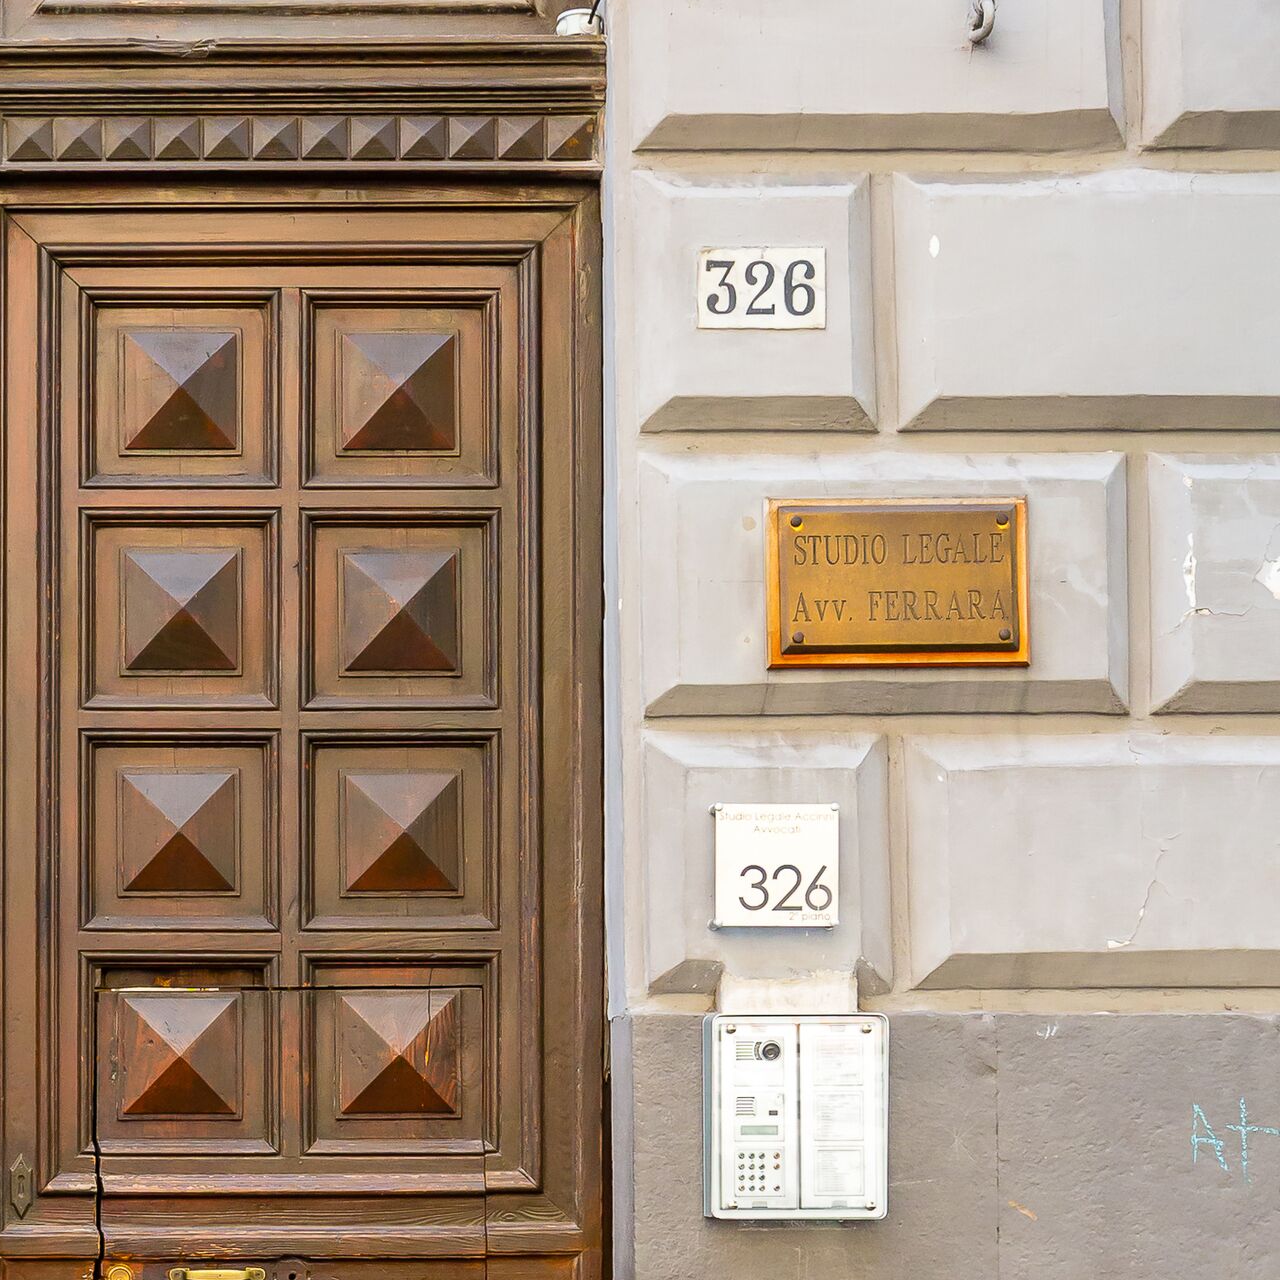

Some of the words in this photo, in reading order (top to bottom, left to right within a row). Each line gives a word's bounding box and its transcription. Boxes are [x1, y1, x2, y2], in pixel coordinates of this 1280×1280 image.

[706, 260, 815, 316] 326
[793, 534, 888, 566] STUDIO
[902, 532, 1005, 564] LEGALE
[868, 589, 1008, 621] FERRARA
[719, 811, 752, 822] Studio
[755, 811, 791, 825] Legale
[753, 824, 801, 834] Avvocati
[738, 864, 833, 911] 326
[801, 911, 831, 923] piano
